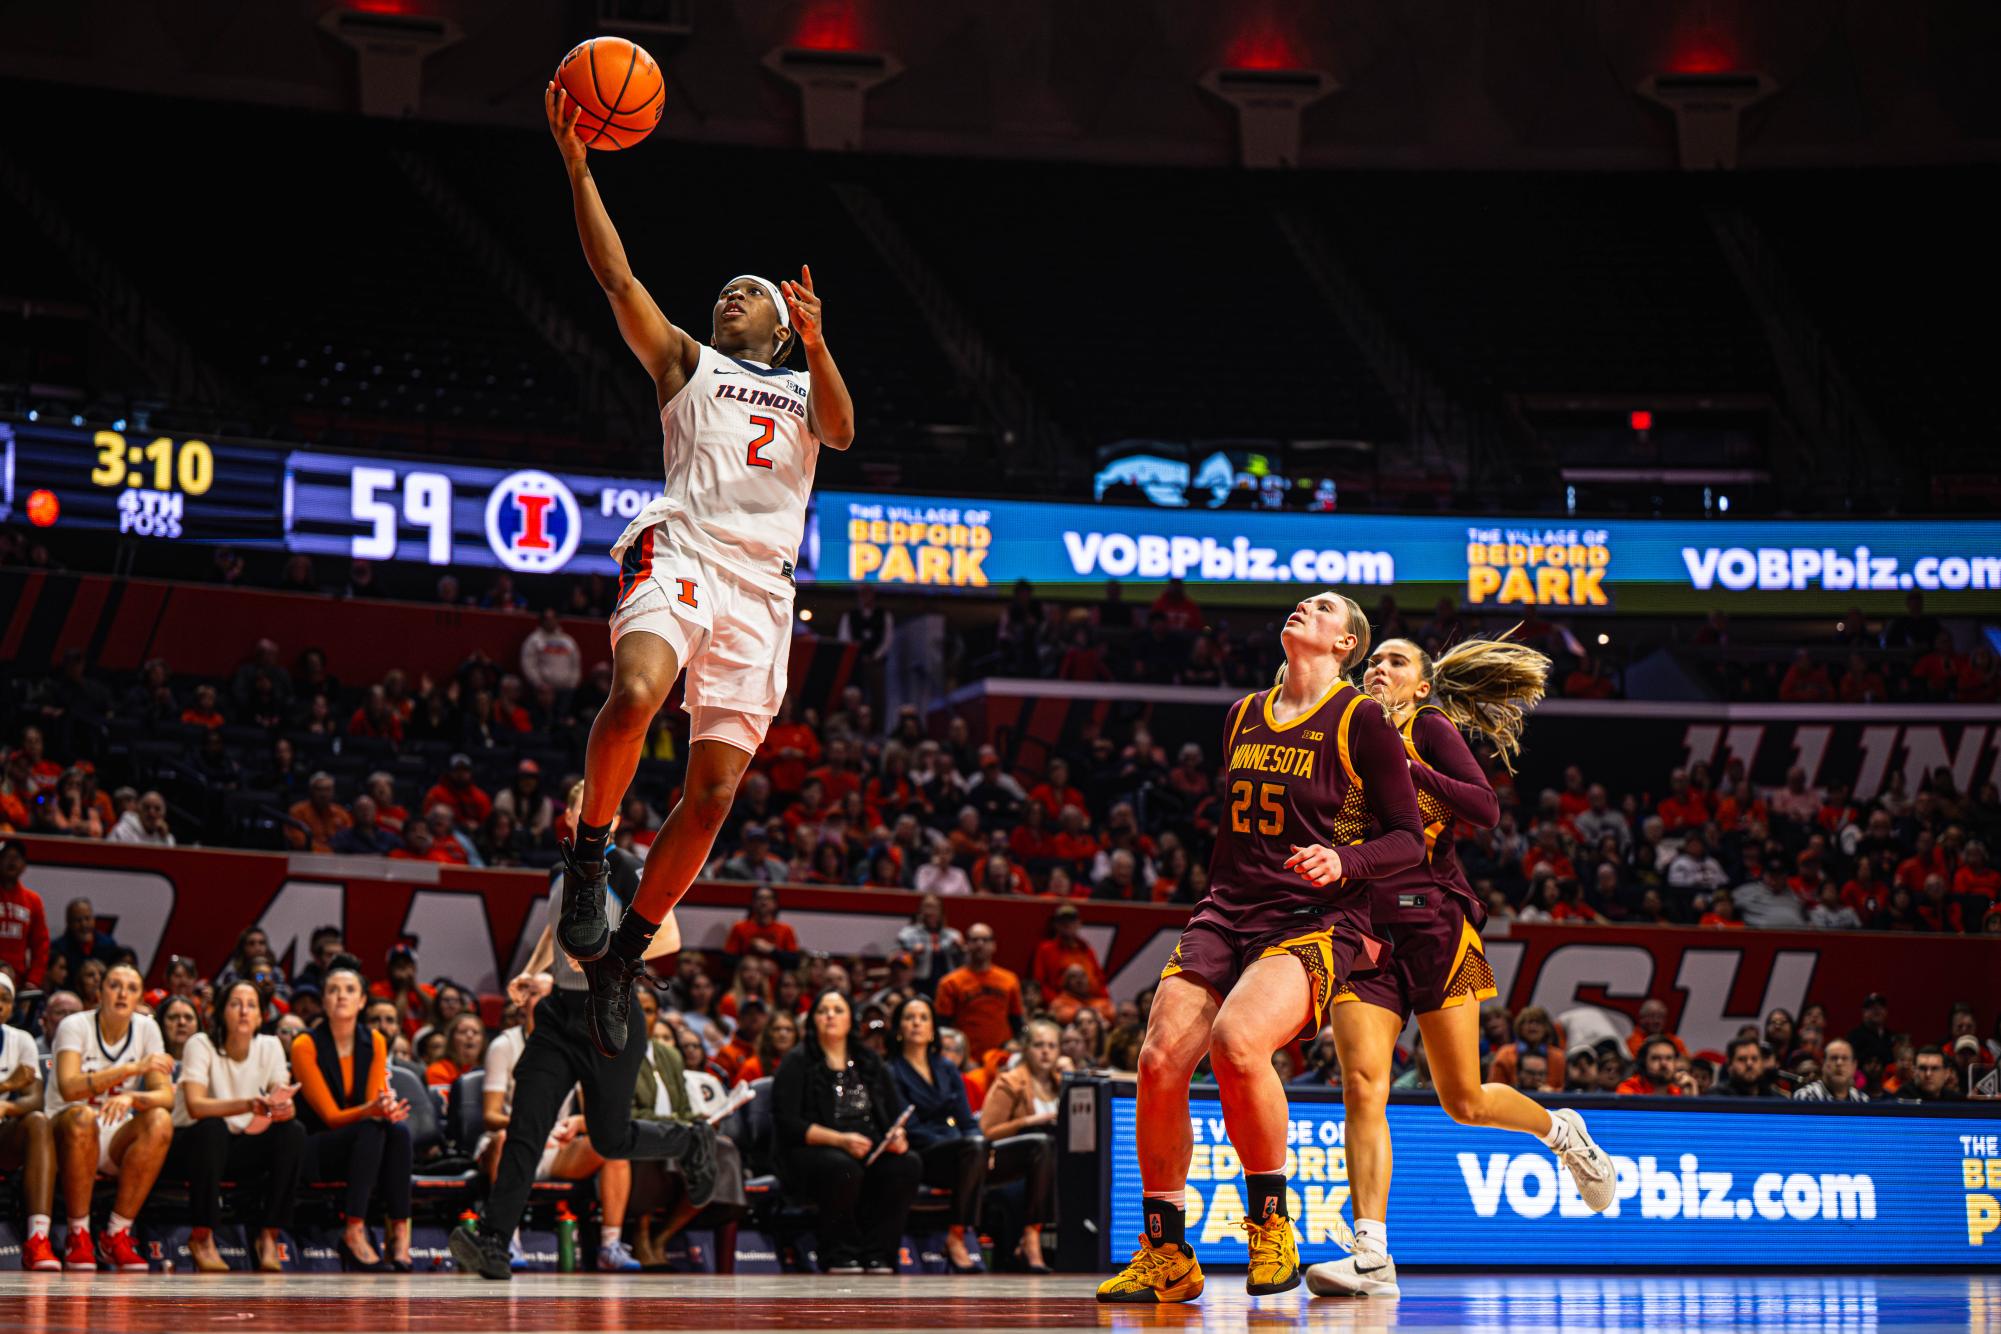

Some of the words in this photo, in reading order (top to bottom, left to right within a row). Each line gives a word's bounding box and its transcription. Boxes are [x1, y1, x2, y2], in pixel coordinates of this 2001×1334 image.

[715, 384, 805, 418] ILLINOIS
[746, 415, 775, 469] 2
[92, 431, 213, 495] 3:10
[117, 489, 183, 517] 4TH
[350, 467, 452, 564] 59
[848, 503, 883, 520] THE
[886, 506, 960, 524] VILLAGE
[963, 510, 991, 526] OF
[119, 511, 183, 537] POSS
[849, 519, 992, 549] BEDFORD
[1467, 528, 1501, 544] THE
[1505, 528, 1579, 545] VILLAGE
[1582, 530, 1608, 546] OF
[849, 543, 989, 587] PARK
[1062, 531, 1394, 585] VOBPbiz.com
[1467, 543, 1610, 568] BEDFORD
[1468, 565, 1609, 606] PARK
[1229, 745, 1316, 779] MINNESOTA
[1231, 779, 1286, 836] 25
[1959, 1135, 1999, 1156] THE
